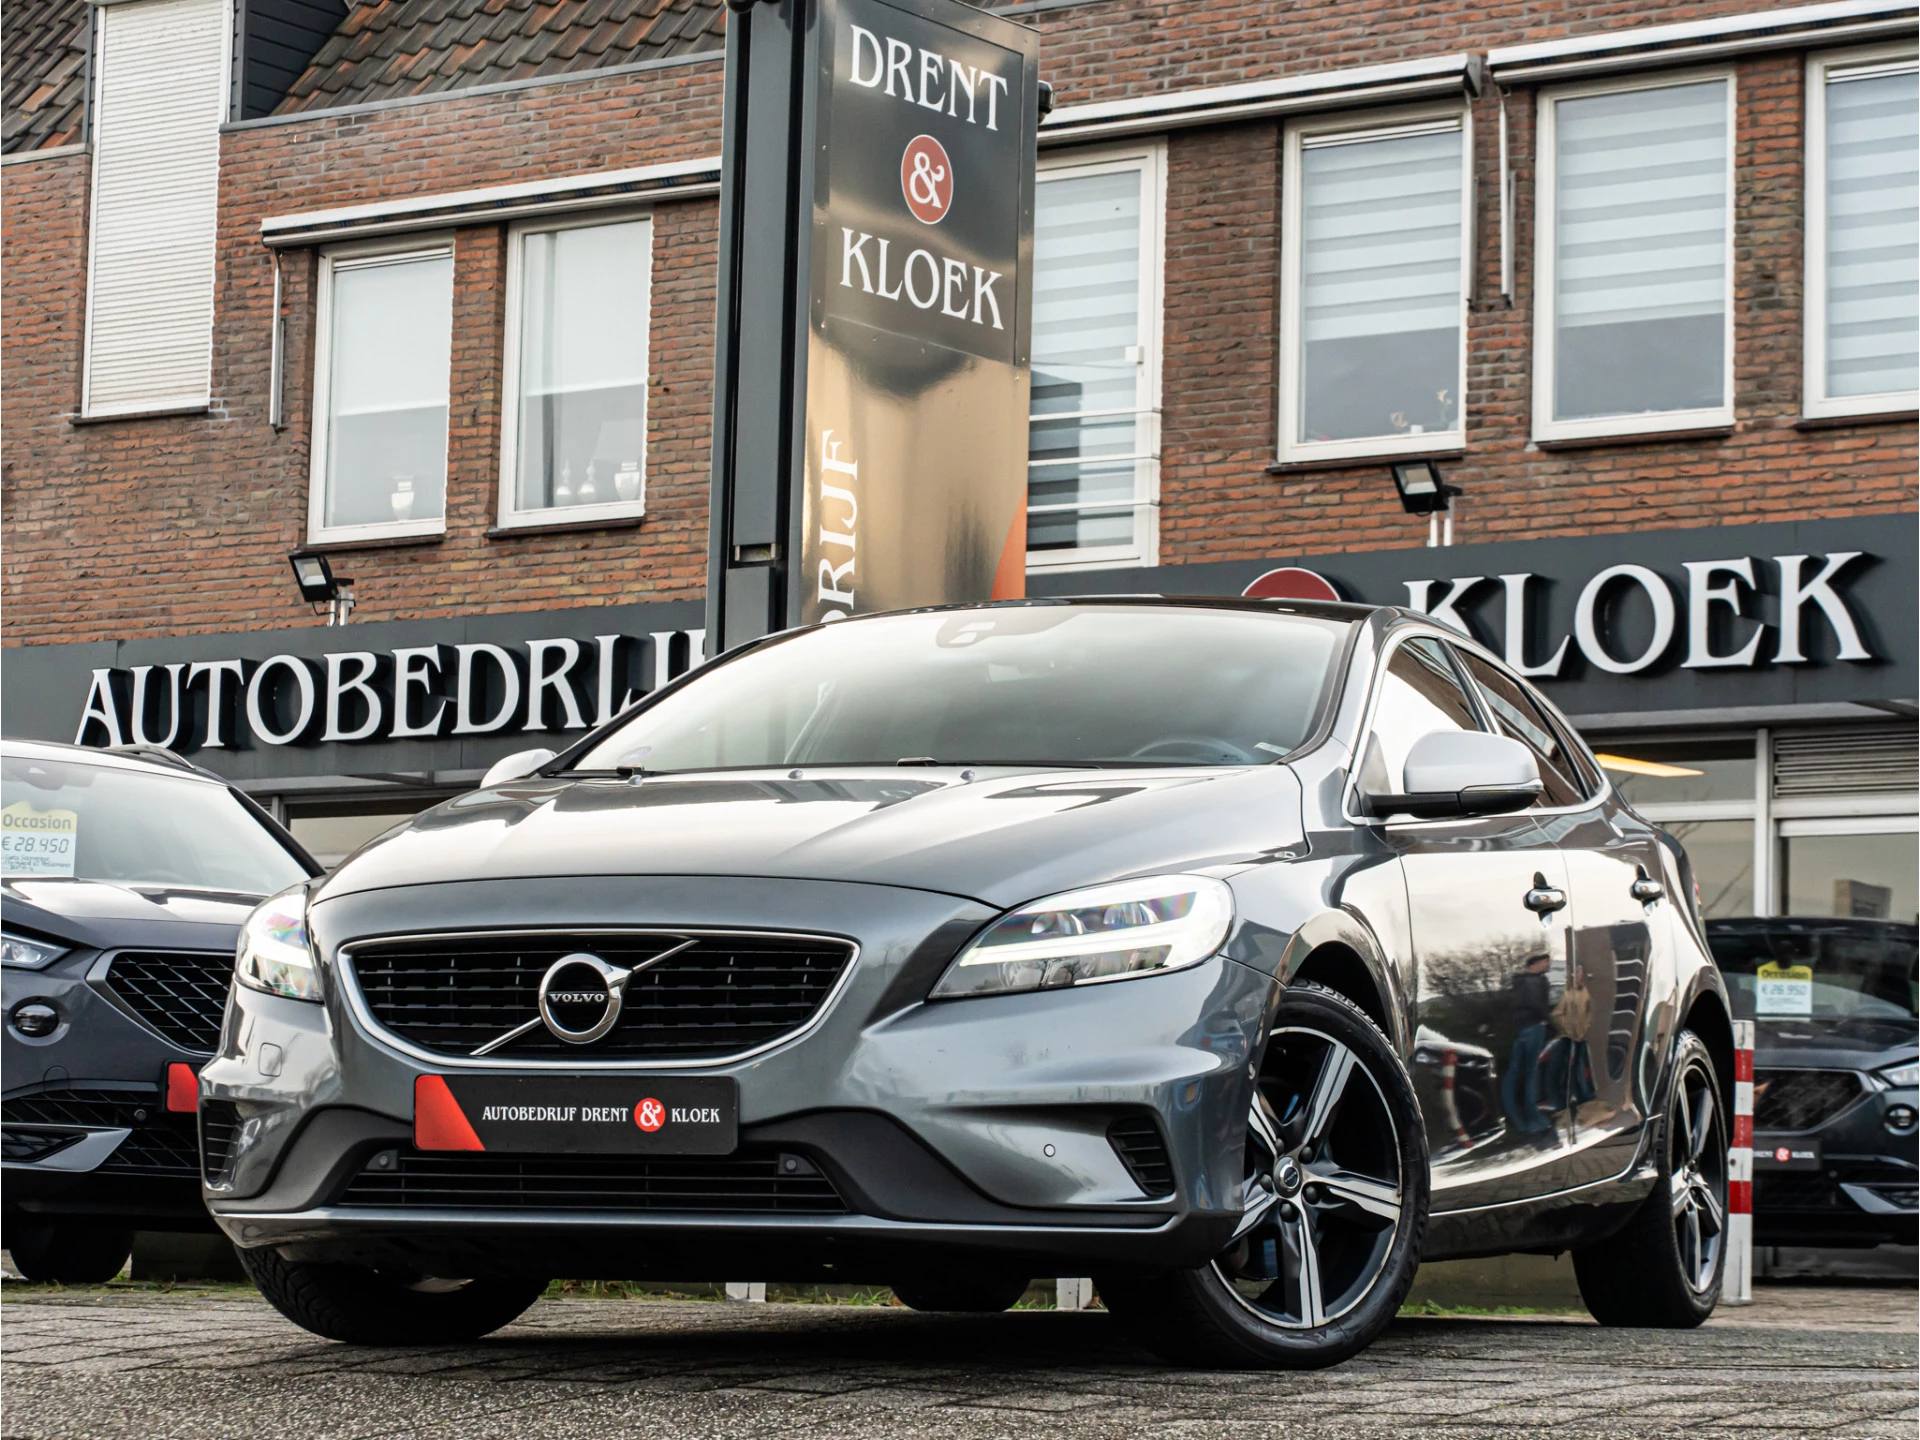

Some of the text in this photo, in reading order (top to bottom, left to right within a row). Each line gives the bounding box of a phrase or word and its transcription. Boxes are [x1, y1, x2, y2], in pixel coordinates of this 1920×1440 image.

[850, 24, 1008, 131] DRENT
[909, 151, 945, 209] &
[840, 227, 1004, 330] KLOEK
[1402, 551, 1870, 676] KLOEK
[3, 814, 71, 829] Occasion
[2, 836, 11, 851] €
[549, 993, 605, 1003] VOLVO
[482, 1101, 720, 1127] AUTOBEDRIJF DRENT & KLOEK
